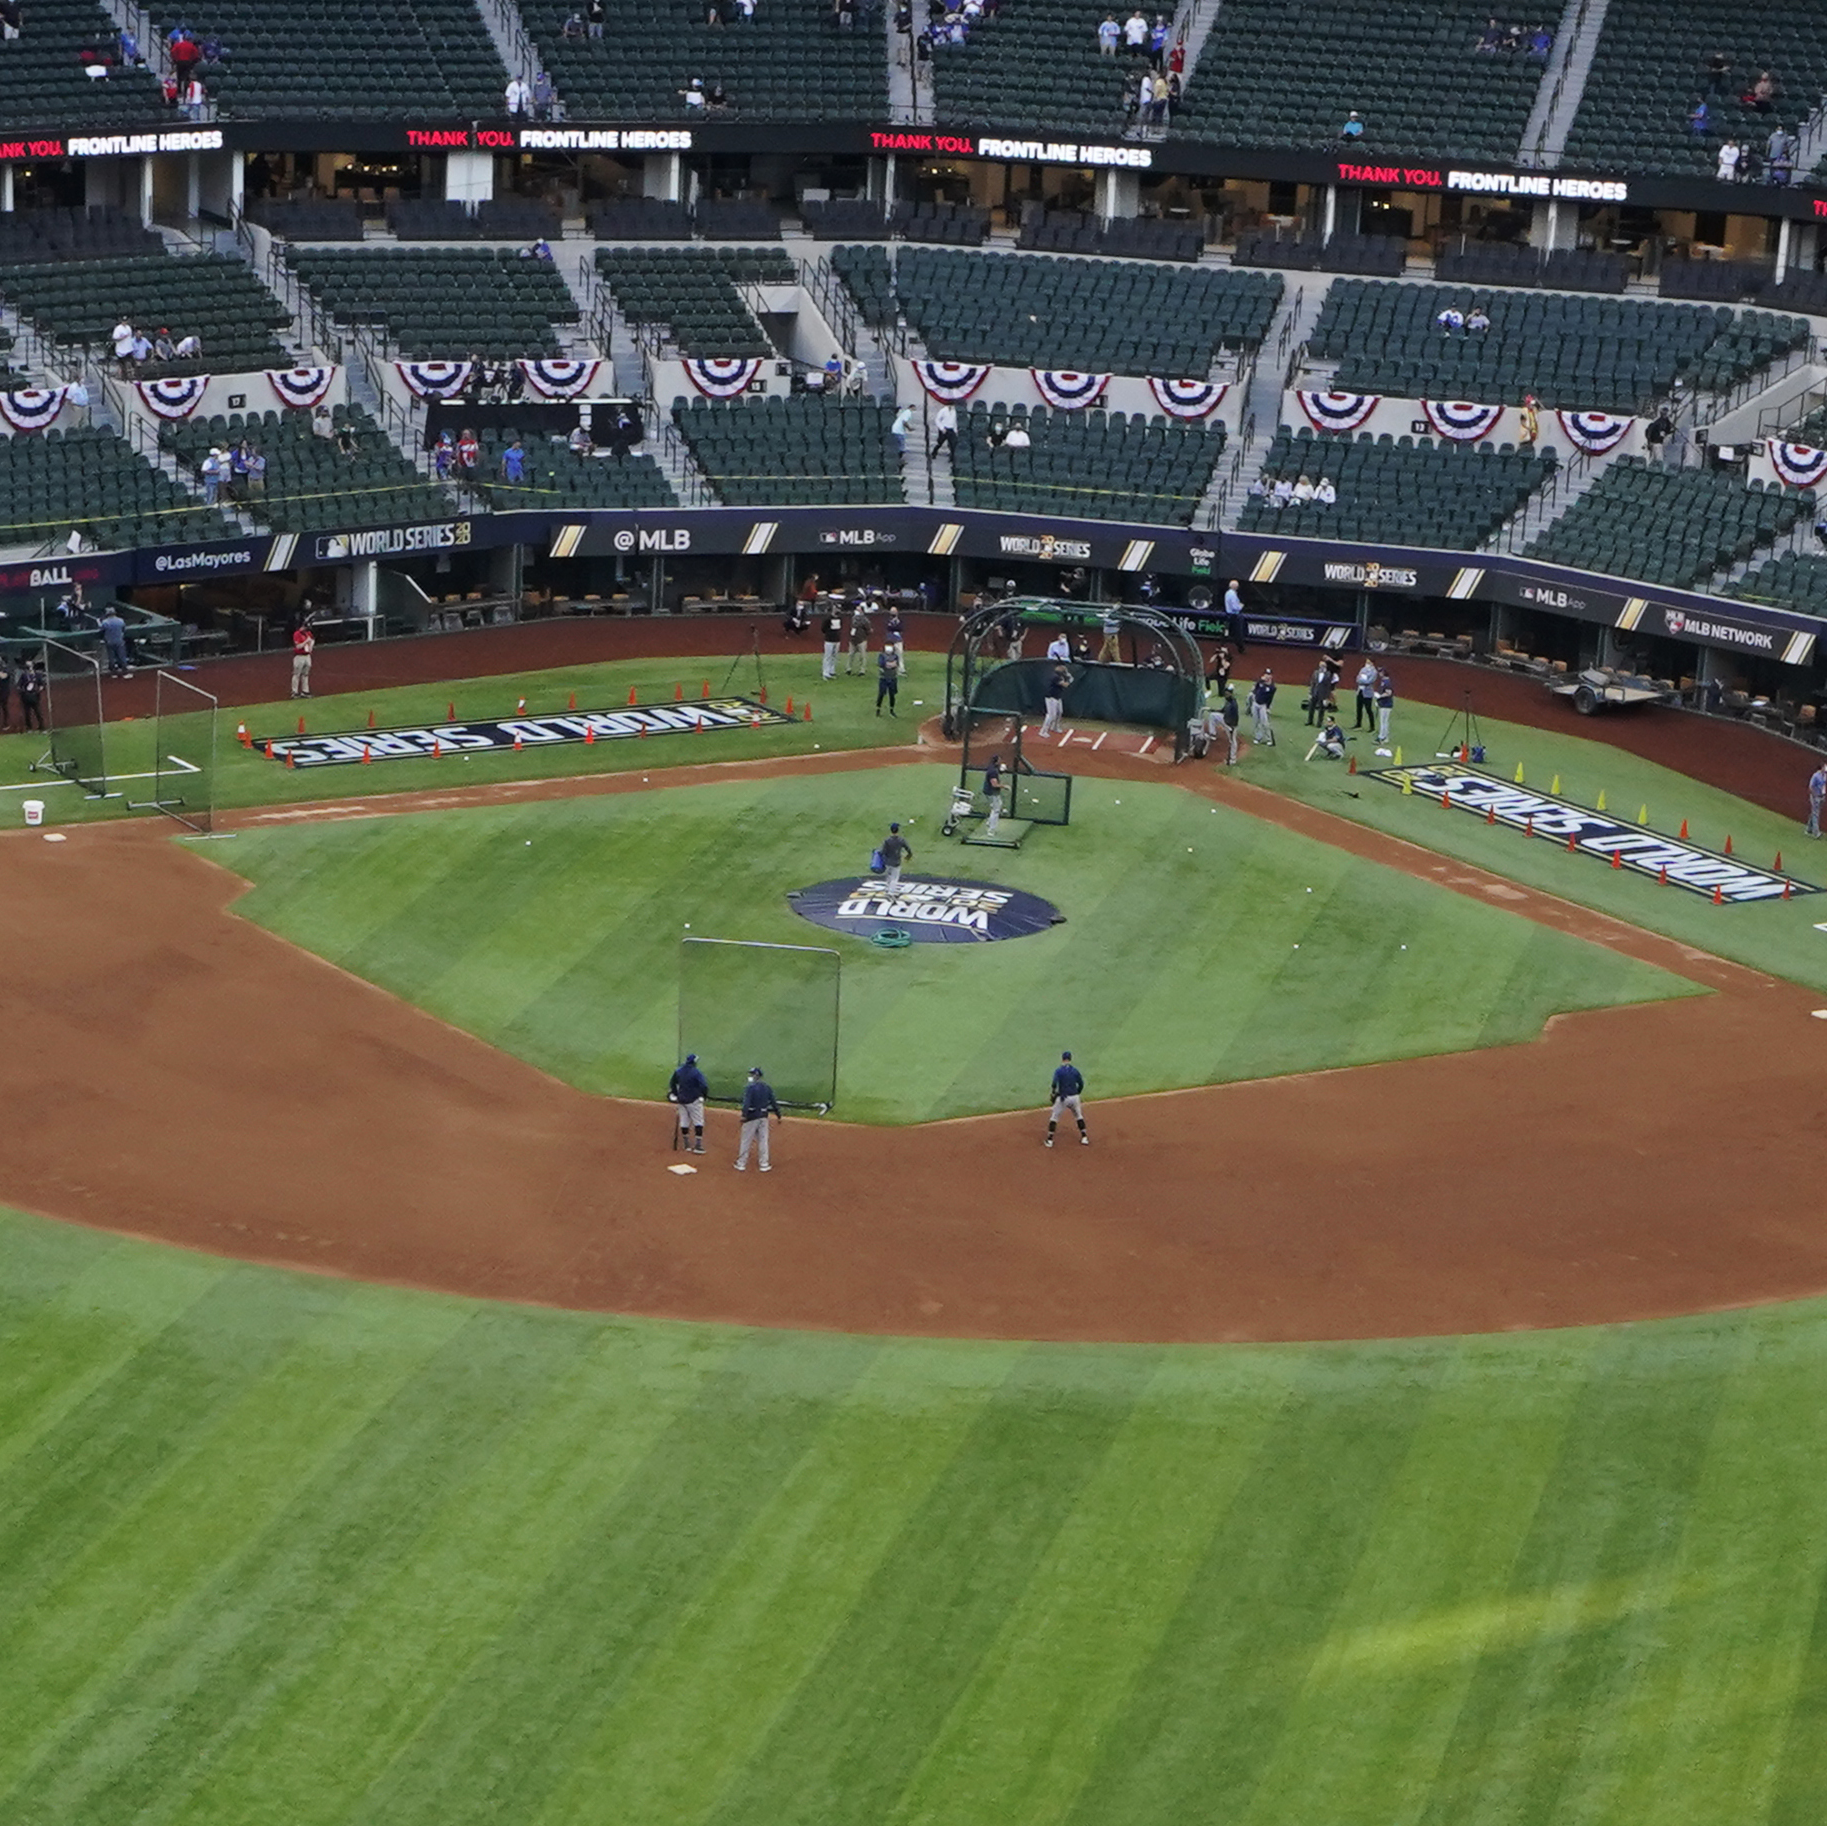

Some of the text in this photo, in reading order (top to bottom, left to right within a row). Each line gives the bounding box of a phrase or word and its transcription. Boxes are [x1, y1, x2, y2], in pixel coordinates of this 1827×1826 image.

[28, 140, 64, 157] YOU.
[68, 134, 158, 156] FRONTLINE
[159, 130, 223, 151] HEROES
[407, 130, 692, 149] THANK YOU. FRONTLINE HEROES
[870, 132, 1152, 167] THANK YOU. FRONTLINE HEROES
[1337, 163, 1628, 200] THANK YOU. FRONTLINE HEROES
[349, 524, 456, 556] WORLD SERIES
[839, 529, 875, 546] MLB
[999, 536, 1091, 558] WORLD SERIES
[155, 551, 251, 572] @LasMayores
[1324, 564, 1417, 586] WORLD SERIES
[1535, 588, 1567, 608] MLB
[1684, 619, 1773, 650] MLB NETWORK
[277, 706, 740, 763] WORLD SERIES
[1413, 776, 1795, 901] WORLD SERIES
[838, 898, 989, 930] WORLD
